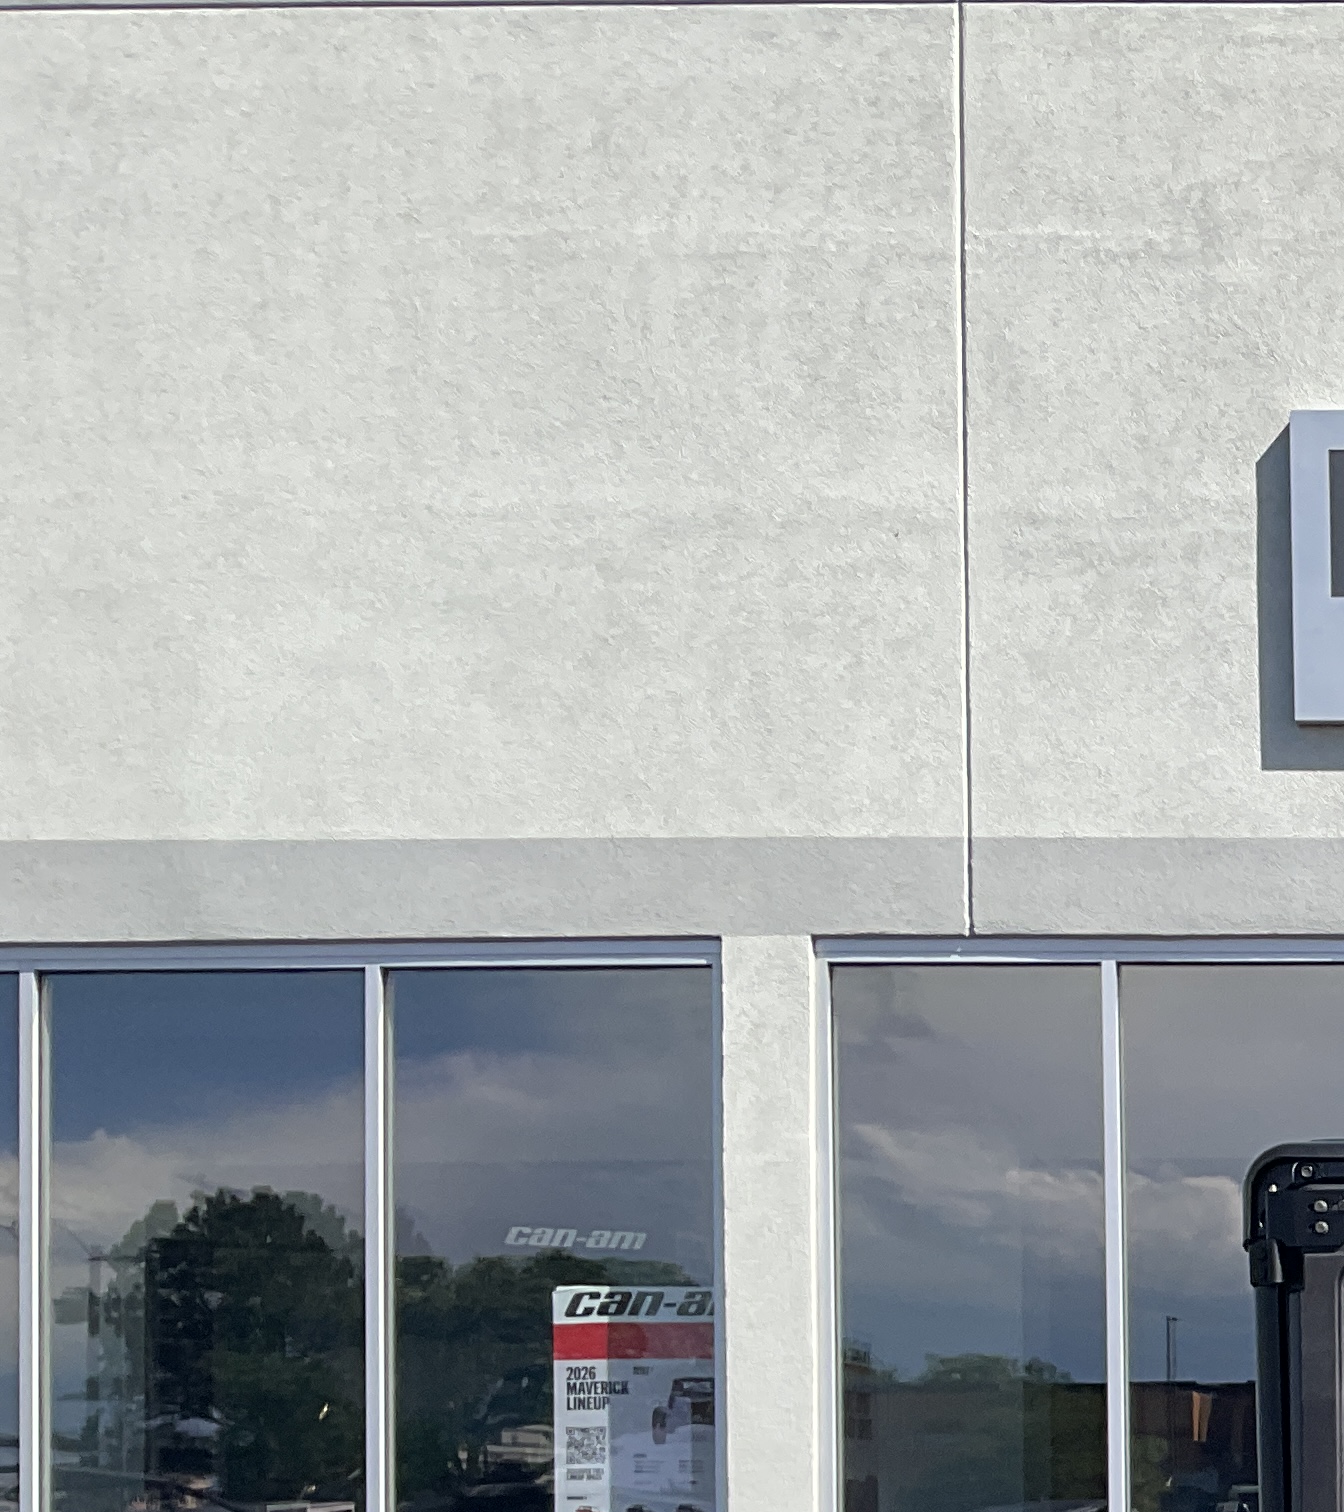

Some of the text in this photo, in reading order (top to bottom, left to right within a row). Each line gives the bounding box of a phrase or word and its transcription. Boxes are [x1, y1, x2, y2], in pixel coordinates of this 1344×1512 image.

[503, 1225, 647, 1250] can-am
[563, 1290, 715, 1319] can-a
[565, 1366, 597, 1381] 2026
[565, 1380, 630, 1396] MAVERICK
[566, 1396, 610, 1411] LINEUP
